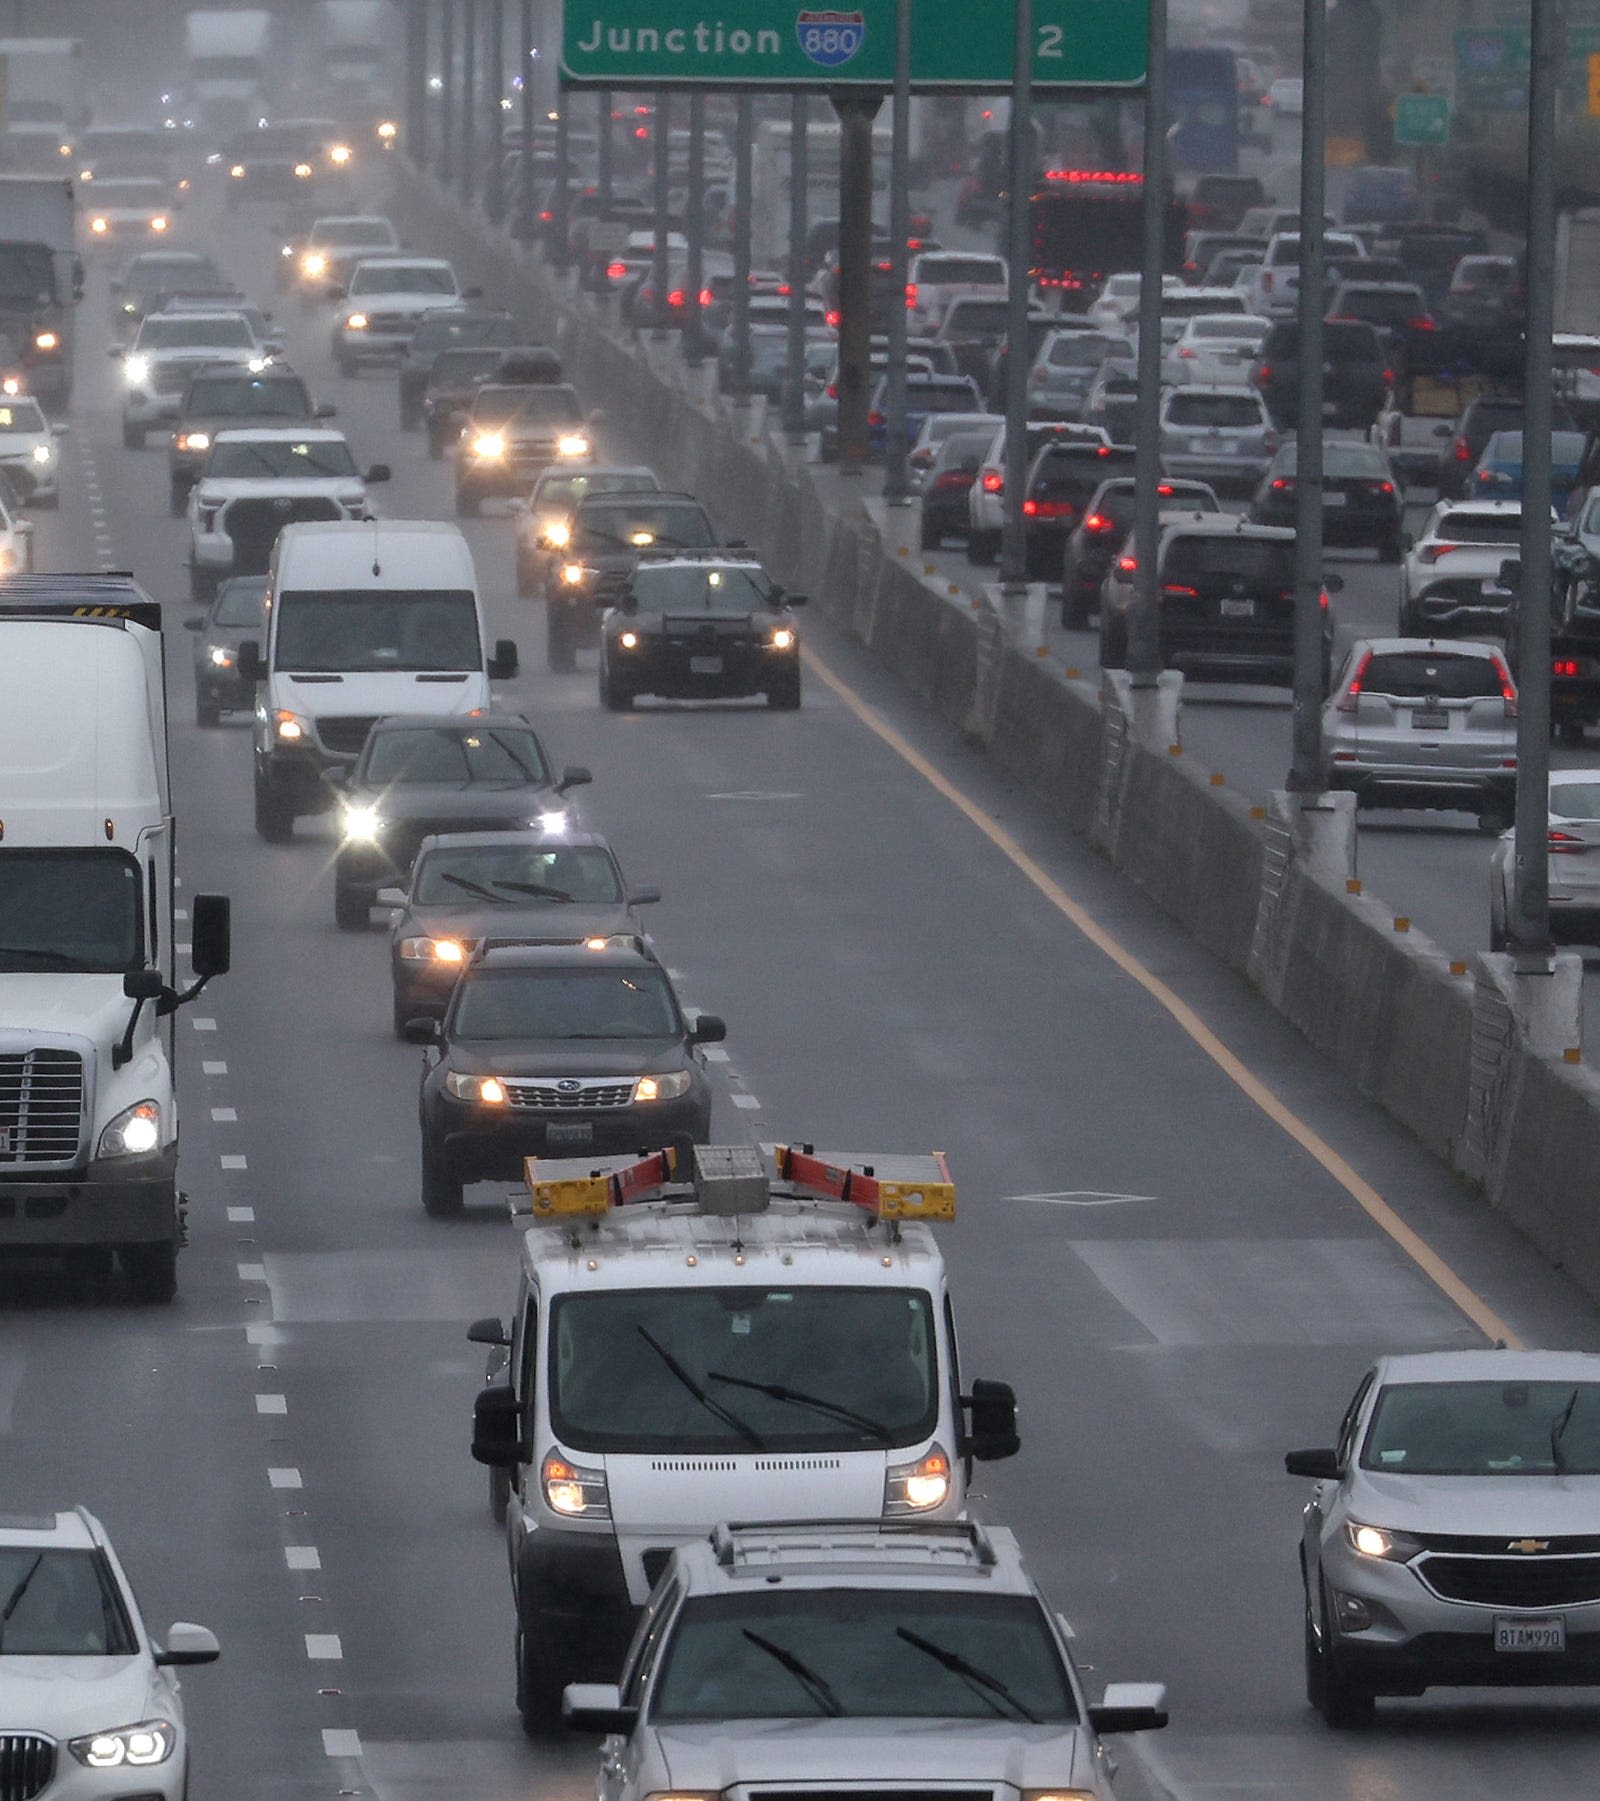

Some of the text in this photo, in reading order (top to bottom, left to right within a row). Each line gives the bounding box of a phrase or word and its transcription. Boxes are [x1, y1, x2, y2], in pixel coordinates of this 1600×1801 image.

[577, 20, 1063, 57] Junction 880 2
[1500, 1629, 1560, 1646] 8TAM990
